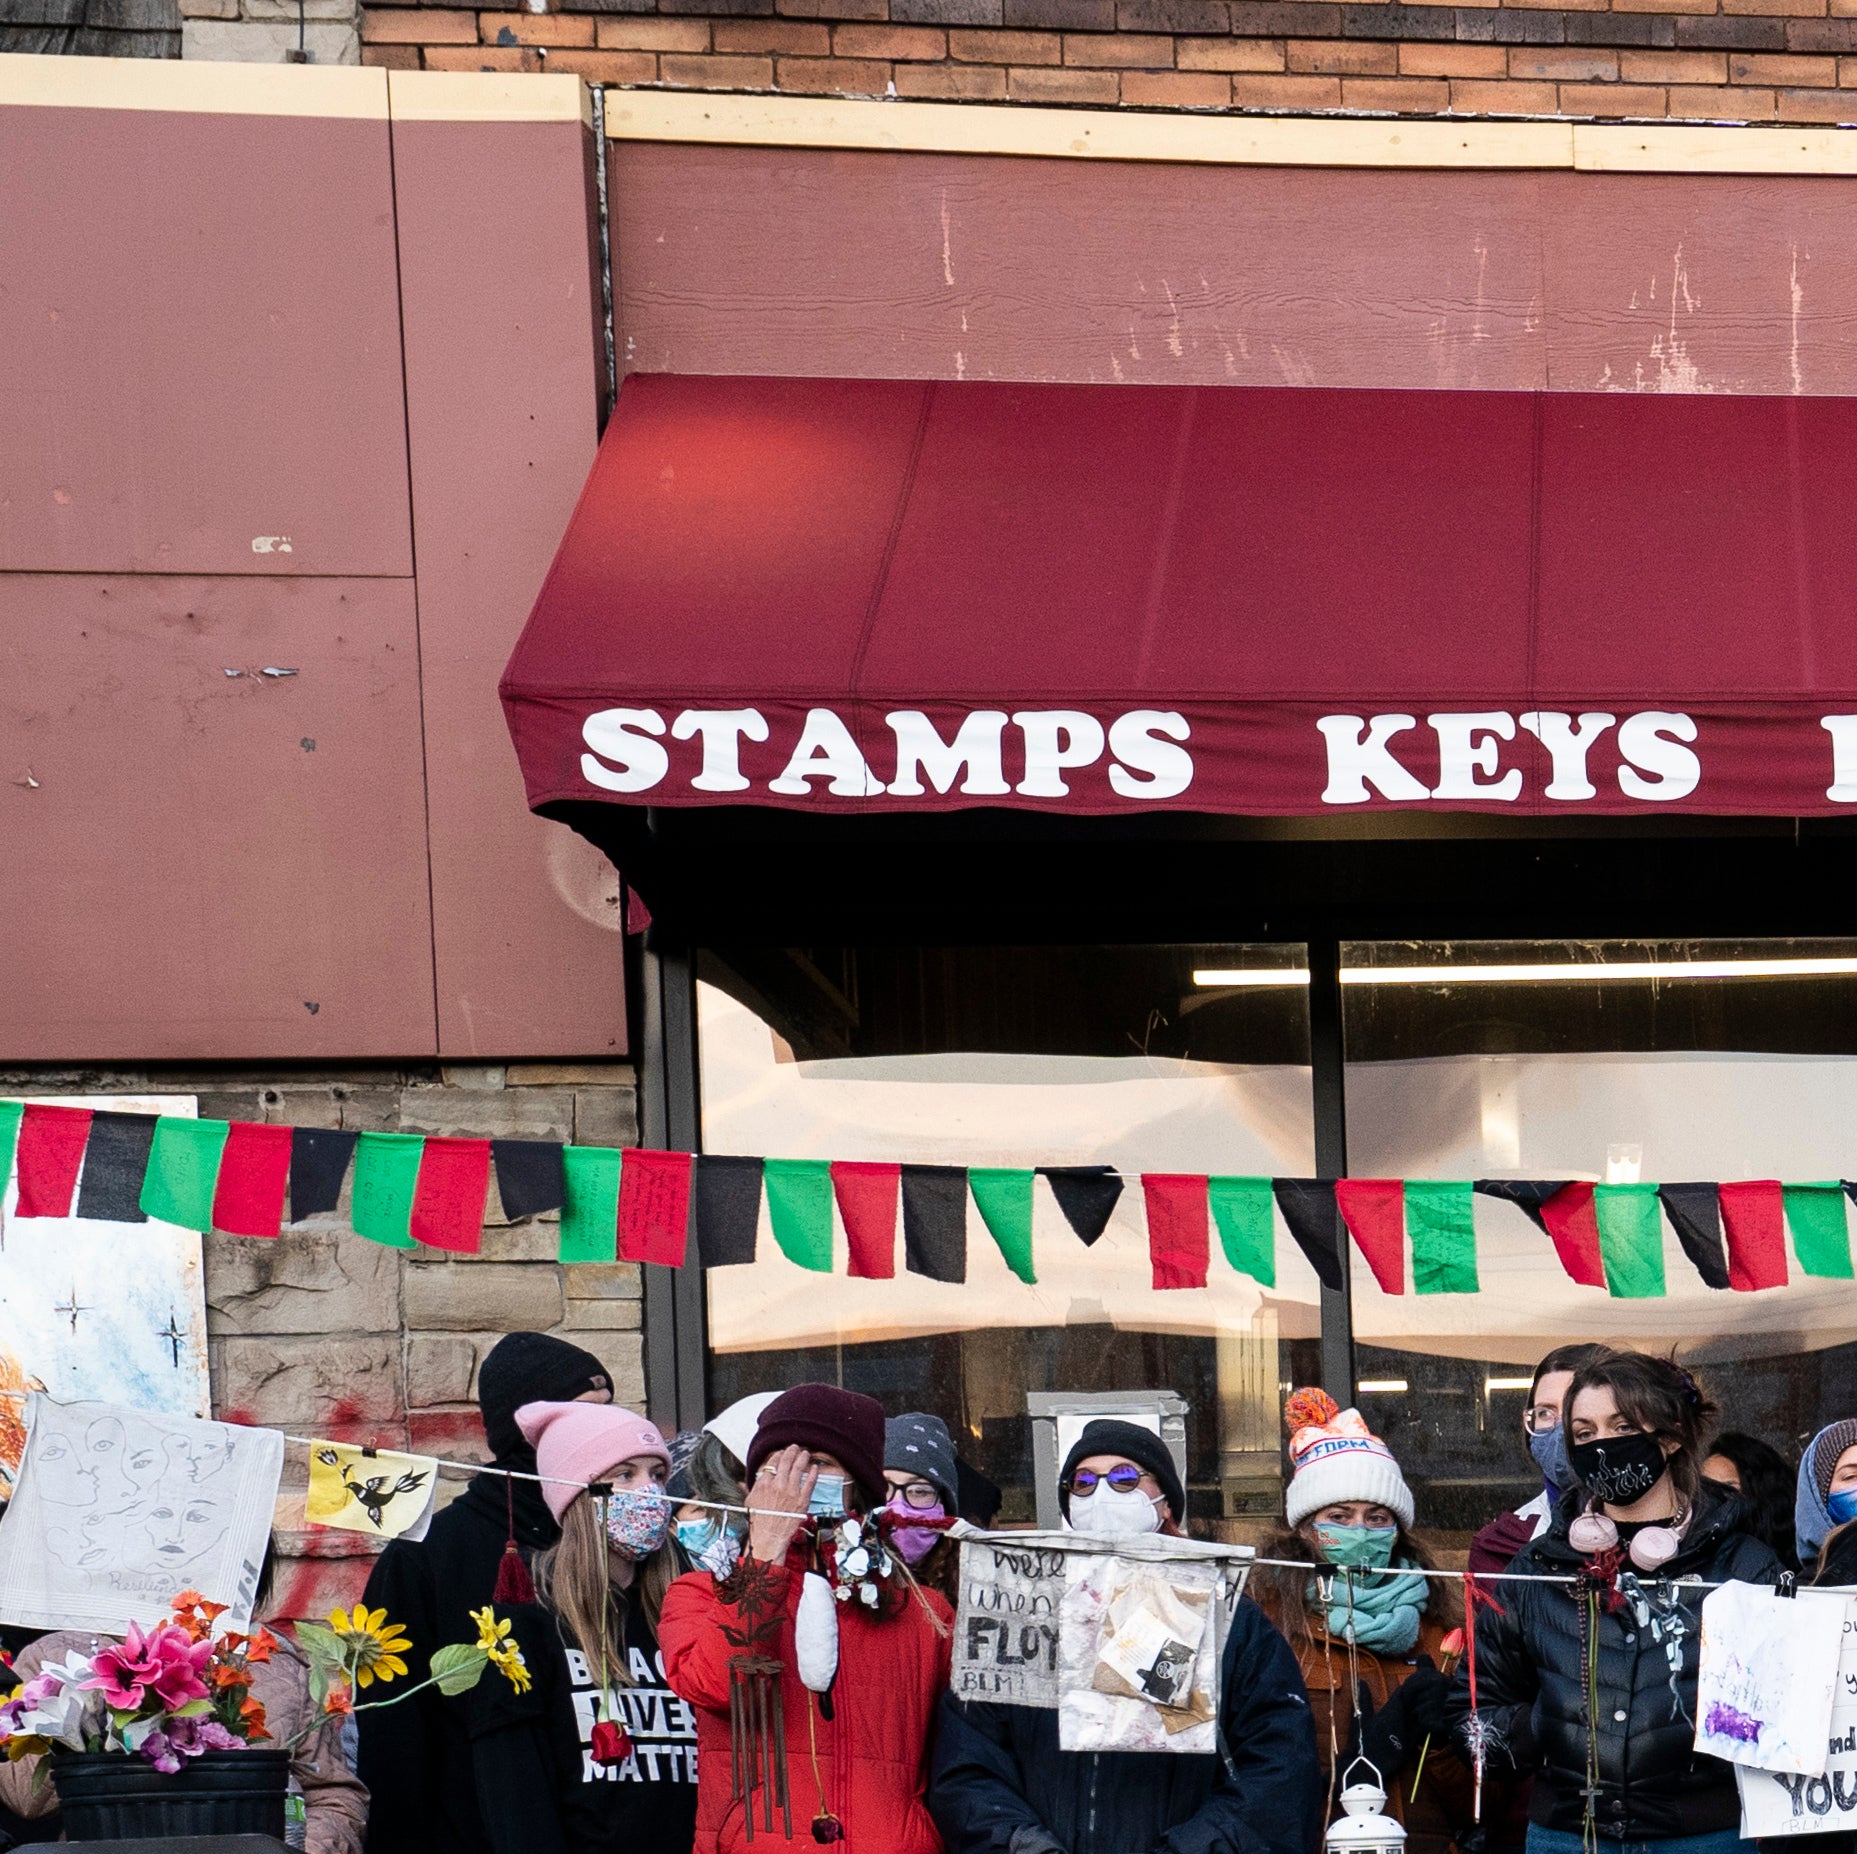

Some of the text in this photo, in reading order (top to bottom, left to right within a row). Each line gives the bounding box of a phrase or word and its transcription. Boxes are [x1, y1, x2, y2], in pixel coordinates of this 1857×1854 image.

[581, 707, 1193, 800] STAMPS
[1317, 711, 1701, 803] KEYS
[968, 1582, 1051, 1616] when
[966, 1616, 1060, 1672] FLOY
[581, 1744, 699, 1783] MATTE
